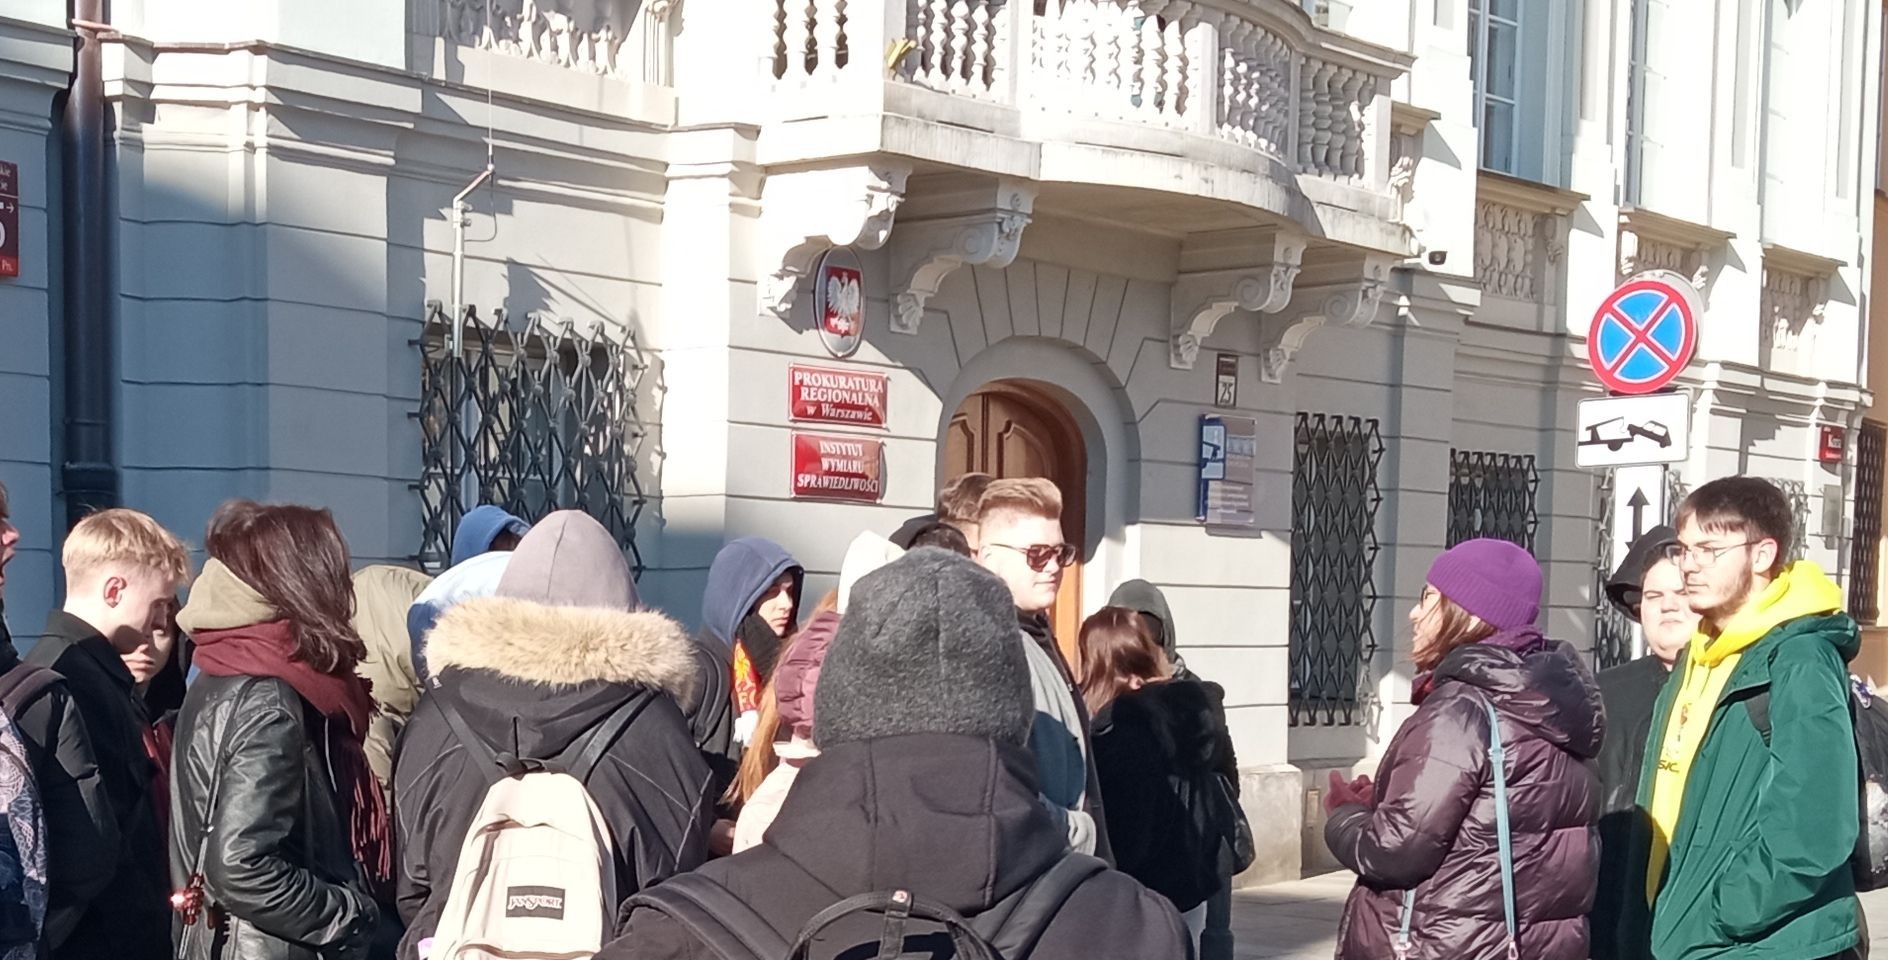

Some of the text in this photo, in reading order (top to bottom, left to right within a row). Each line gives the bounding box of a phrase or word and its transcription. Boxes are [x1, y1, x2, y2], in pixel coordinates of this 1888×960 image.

[793, 371, 883, 393] PROKURATURA
[800, 387, 880, 406] REGIONALNA
[806, 403, 873, 420] w Warszawie
[819, 440, 863, 456] INSTYTUT
[821, 457, 864, 474] WYMIARU
[797, 473, 879, 493] SPRAWIEDLIWOŚCI
